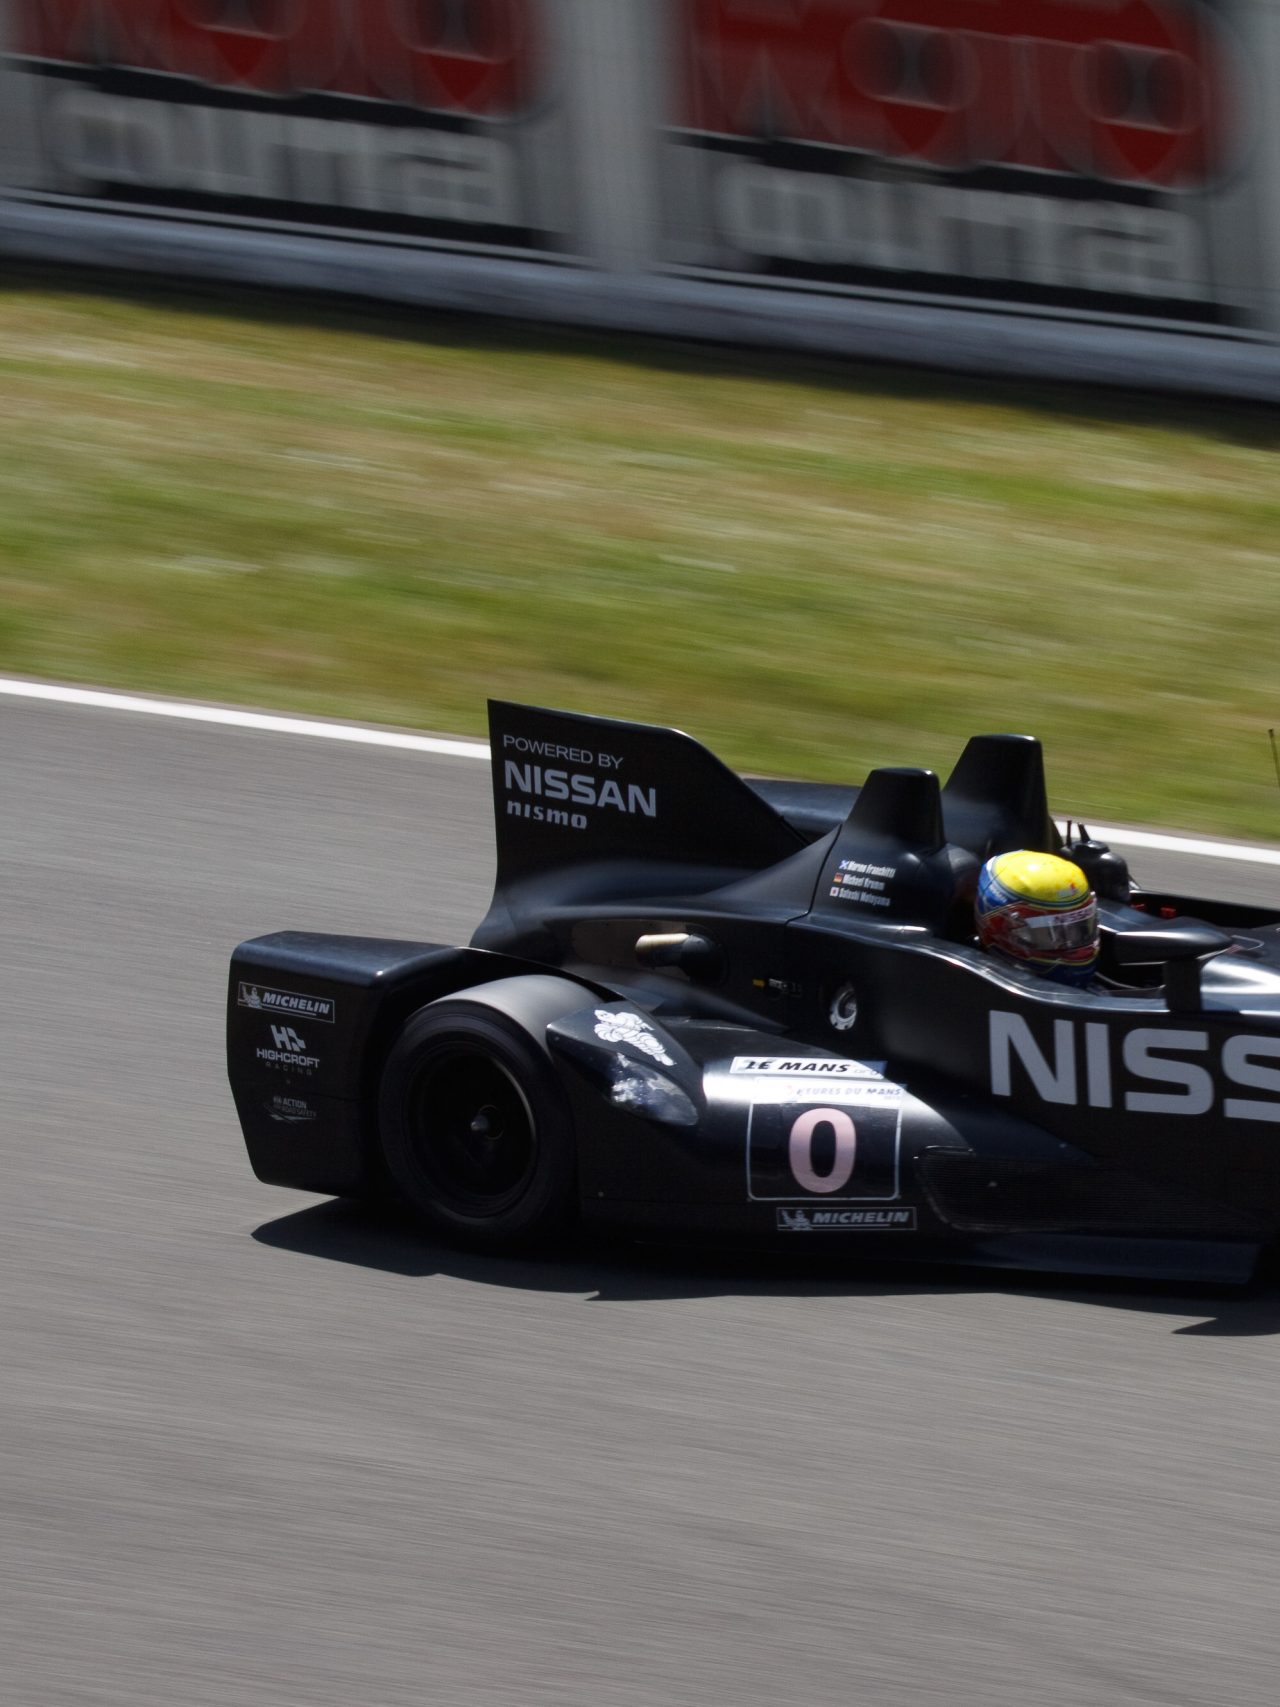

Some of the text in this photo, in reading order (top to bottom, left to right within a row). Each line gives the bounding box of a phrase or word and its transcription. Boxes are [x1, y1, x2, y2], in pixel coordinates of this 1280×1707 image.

[503, 734, 624, 769] POWERED BY
[504, 760, 656, 817] NISSAN
[507, 800, 588, 830] nismo
[262, 992, 330, 1014] MICHELIN
[256, 1048, 320, 1068] HIGHCROFT
[778, 1062, 850, 1073] MANS
[789, 1107, 856, 1193] 0
[812, 1212, 909, 1223] MICHELIN
